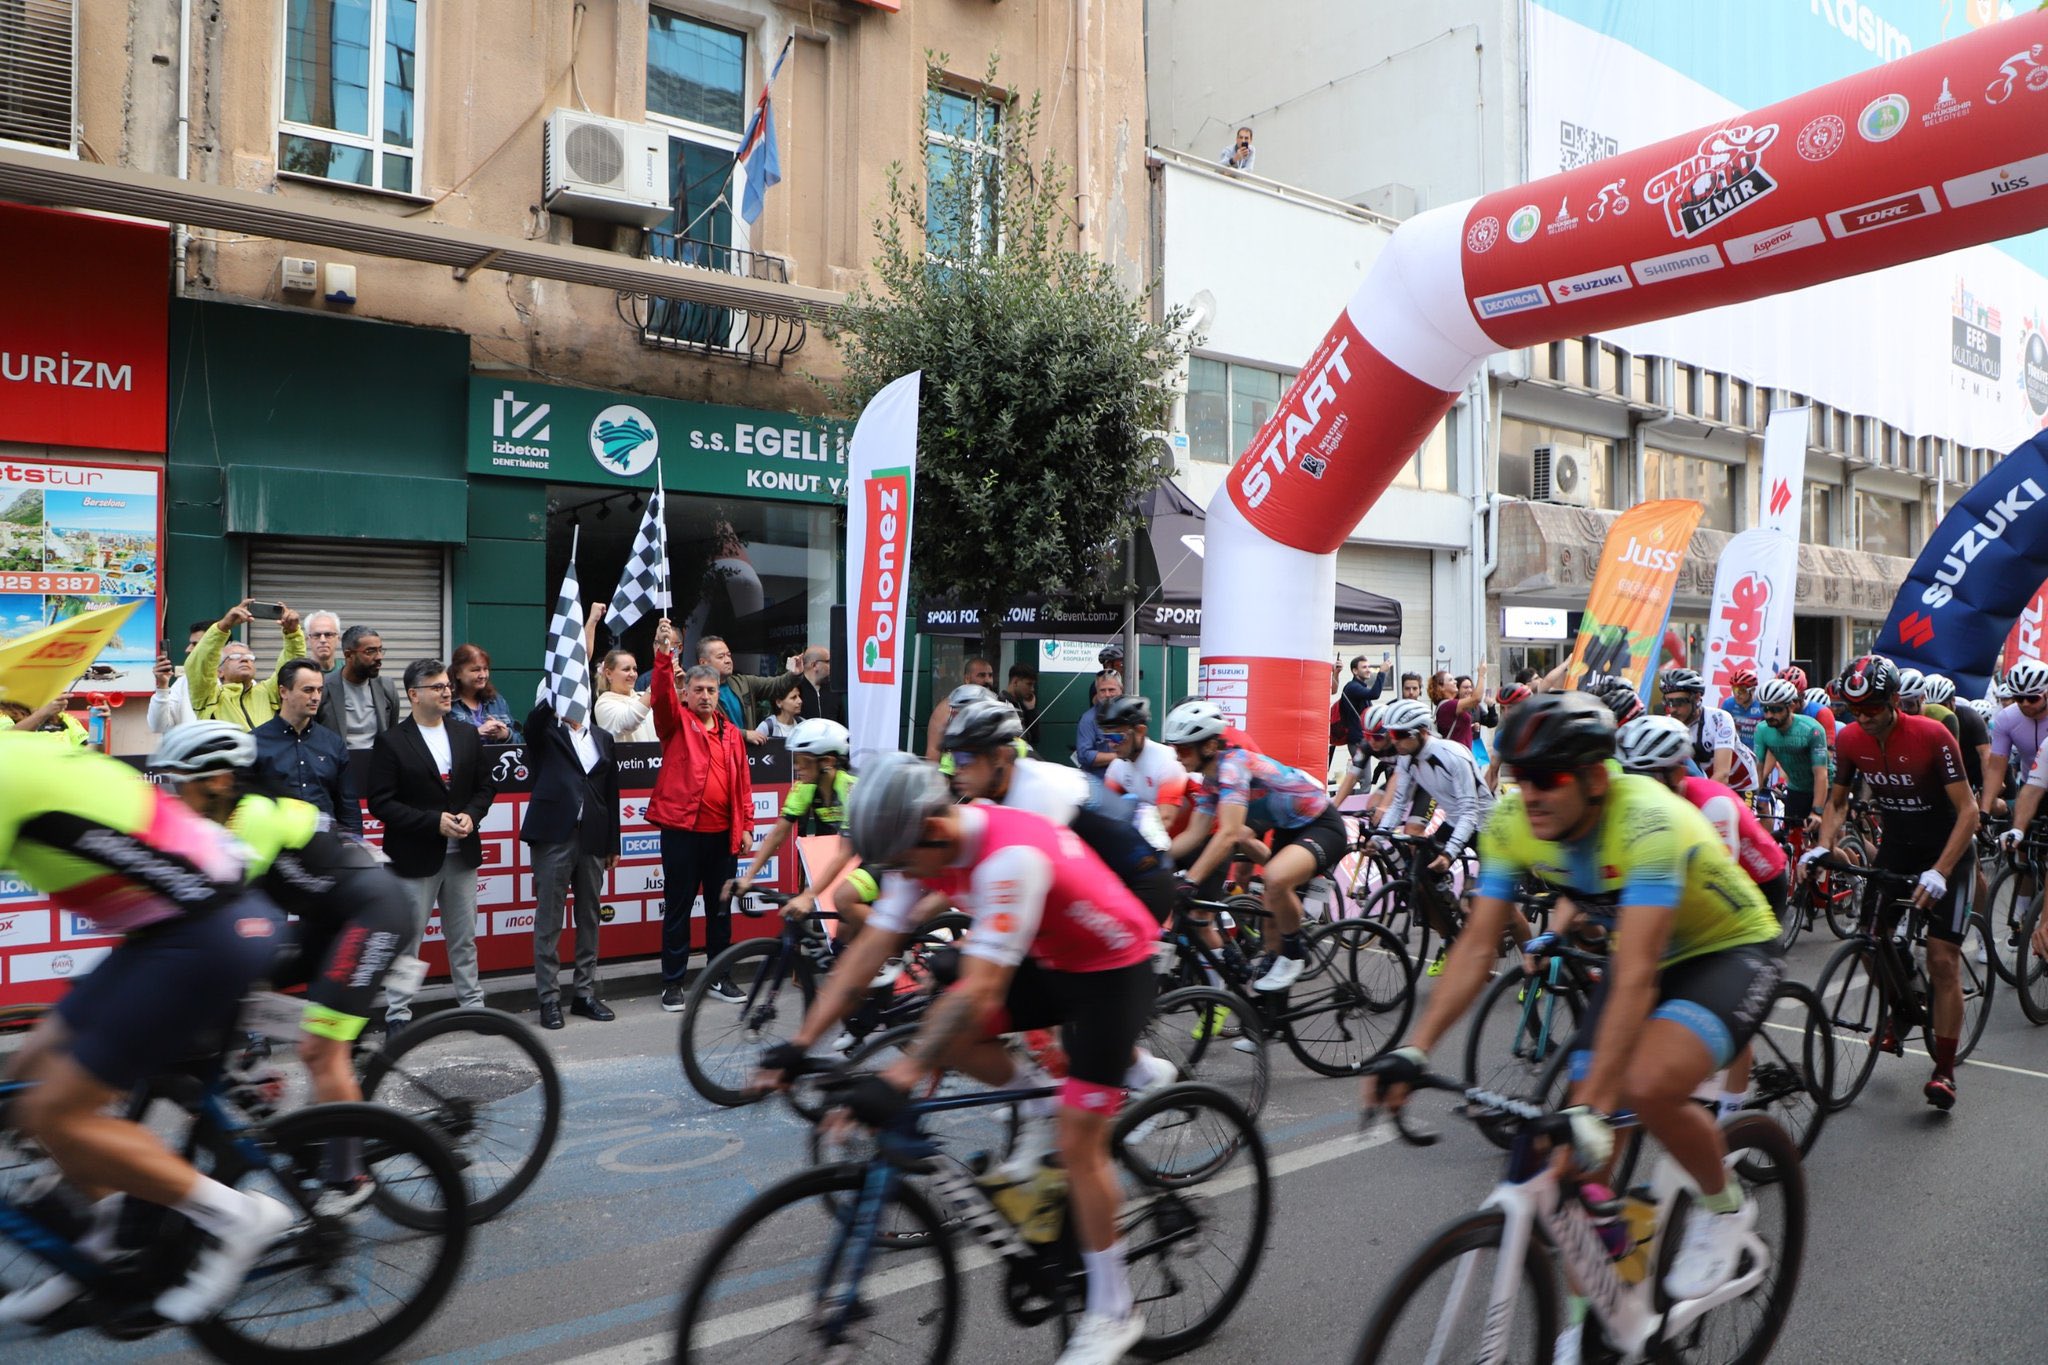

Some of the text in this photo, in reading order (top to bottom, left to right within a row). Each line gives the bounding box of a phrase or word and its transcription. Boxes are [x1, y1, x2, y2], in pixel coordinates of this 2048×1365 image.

[1990, 175, 2030, 196] Juss
[1693, 179, 1758, 227] İZMİR
[1857, 203, 1910, 225] TORC
[1753, 229, 1793, 254] Asperox
[1644, 254, 1711, 277] SHIMANO
[1572, 275, 1623, 293] SUZUKI
[1485, 293, 1539, 313] DECATHLON
[1241, 335, 1352, 509] START
[493, 440, 550, 457] izbeton
[493, 457, 550, 470] DENETİMİNDE
[746, 469, 821, 493] KONUT
[1618, 537, 1681, 572] Juss
[1921, 478, 2047, 609] SUZUKI
[38, 577, 51, 590] 3
[57, 577, 95, 591] 387
[862, 487, 899, 673] Polonez
[1155, 607, 1201, 624] SPORT
